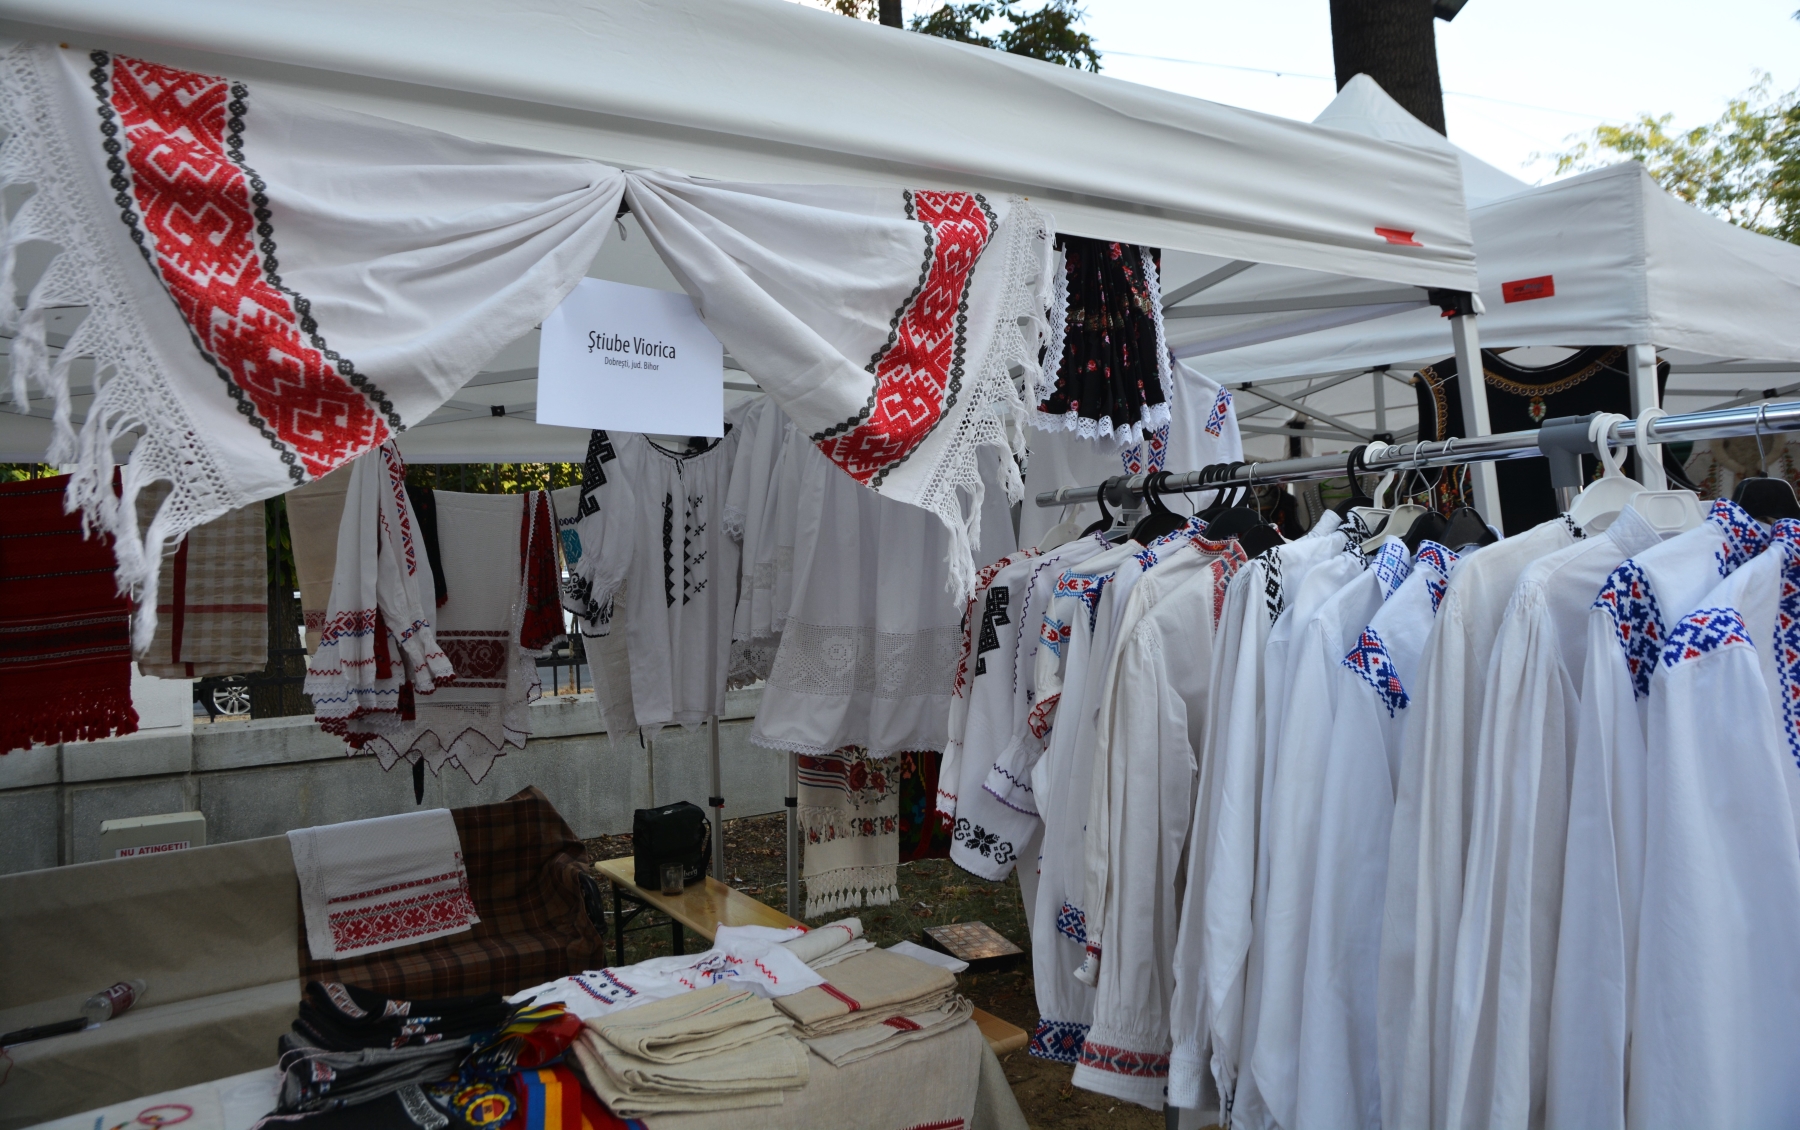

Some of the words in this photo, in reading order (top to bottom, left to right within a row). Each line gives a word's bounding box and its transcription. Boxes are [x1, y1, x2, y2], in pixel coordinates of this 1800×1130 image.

[633, 336, 676, 359] Viorica
[631, 360, 642, 370] jud.
[643, 361, 659, 371] Bihor
[120, 849, 134, 857] NU
